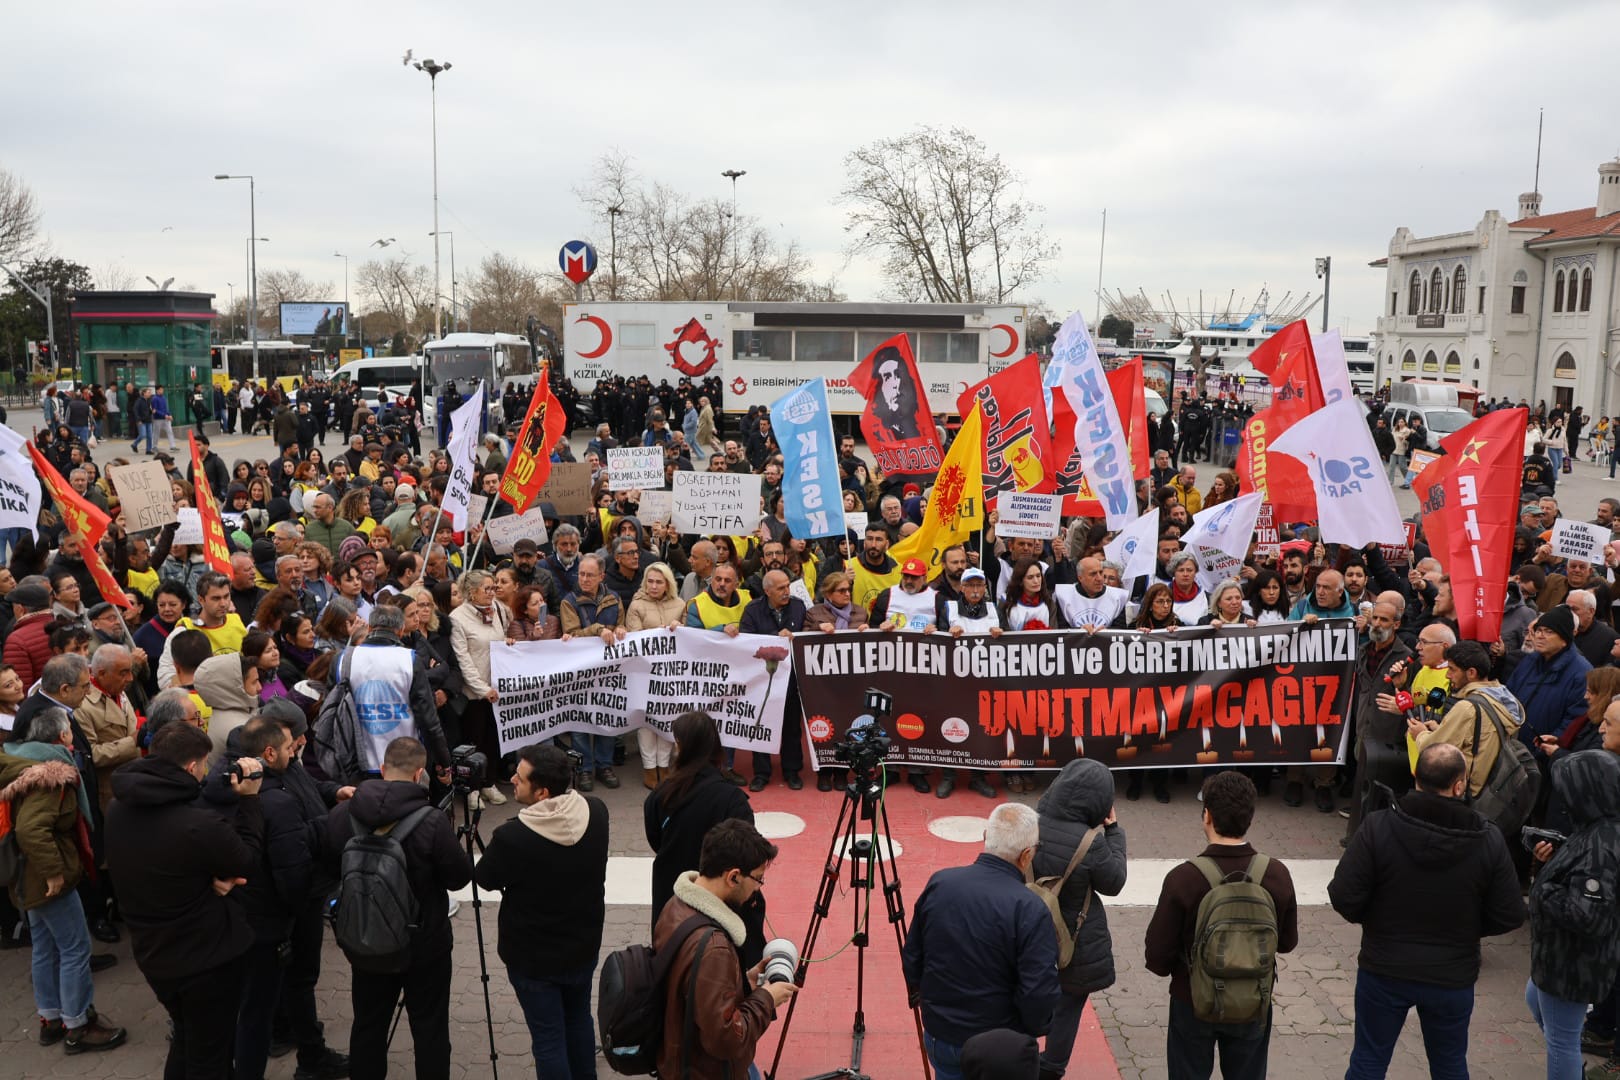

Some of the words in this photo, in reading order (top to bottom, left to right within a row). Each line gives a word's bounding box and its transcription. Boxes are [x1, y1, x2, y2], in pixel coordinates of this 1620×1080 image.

[574, 369, 614, 379] KIZILAY
[693, 513, 744, 529] İSTİFA
[1559, 538, 1593, 550] PARASIZ
[603, 640, 638, 660] AYLA
[641, 636, 677, 656] KARA
[804, 636, 946, 676] KATLEDİLEN
[953, 637, 1065, 678] ÖĞRENCİ
[1070, 647, 1102, 675] ve
[1110, 623, 1356, 675] ÖĞRETMENLERİMİZİ
[498, 674, 545, 693] BELİNAY
[549, 671, 574, 686] NUR
[577, 664, 621, 680] POYRAZ
[650, 661, 688, 677] ZEYNEP
[691, 662, 730, 681] KILINÇ
[498, 691, 540, 706] ADNAN
[542, 679, 595, 699] GÖKTÜRK
[599, 673, 627, 691] YEŞİL
[648, 680, 699, 696] MUSTAFA
[702, 682, 746, 697] ARSLAN
[499, 700, 553, 726] ŞURANUR
[556, 691, 588, 708] SEVGİ
[591, 692, 627, 711] KAZICI
[646, 701, 694, 716] BAYRAM
[726, 699, 756, 719] ŞİŞİK
[978, 664, 1341, 738] UNUTMAYACAĞIZ
[502, 720, 546, 742] FURKAN
[548, 710, 593, 728] SANCAK
[930, 755, 958, 763] İSTANBUL
